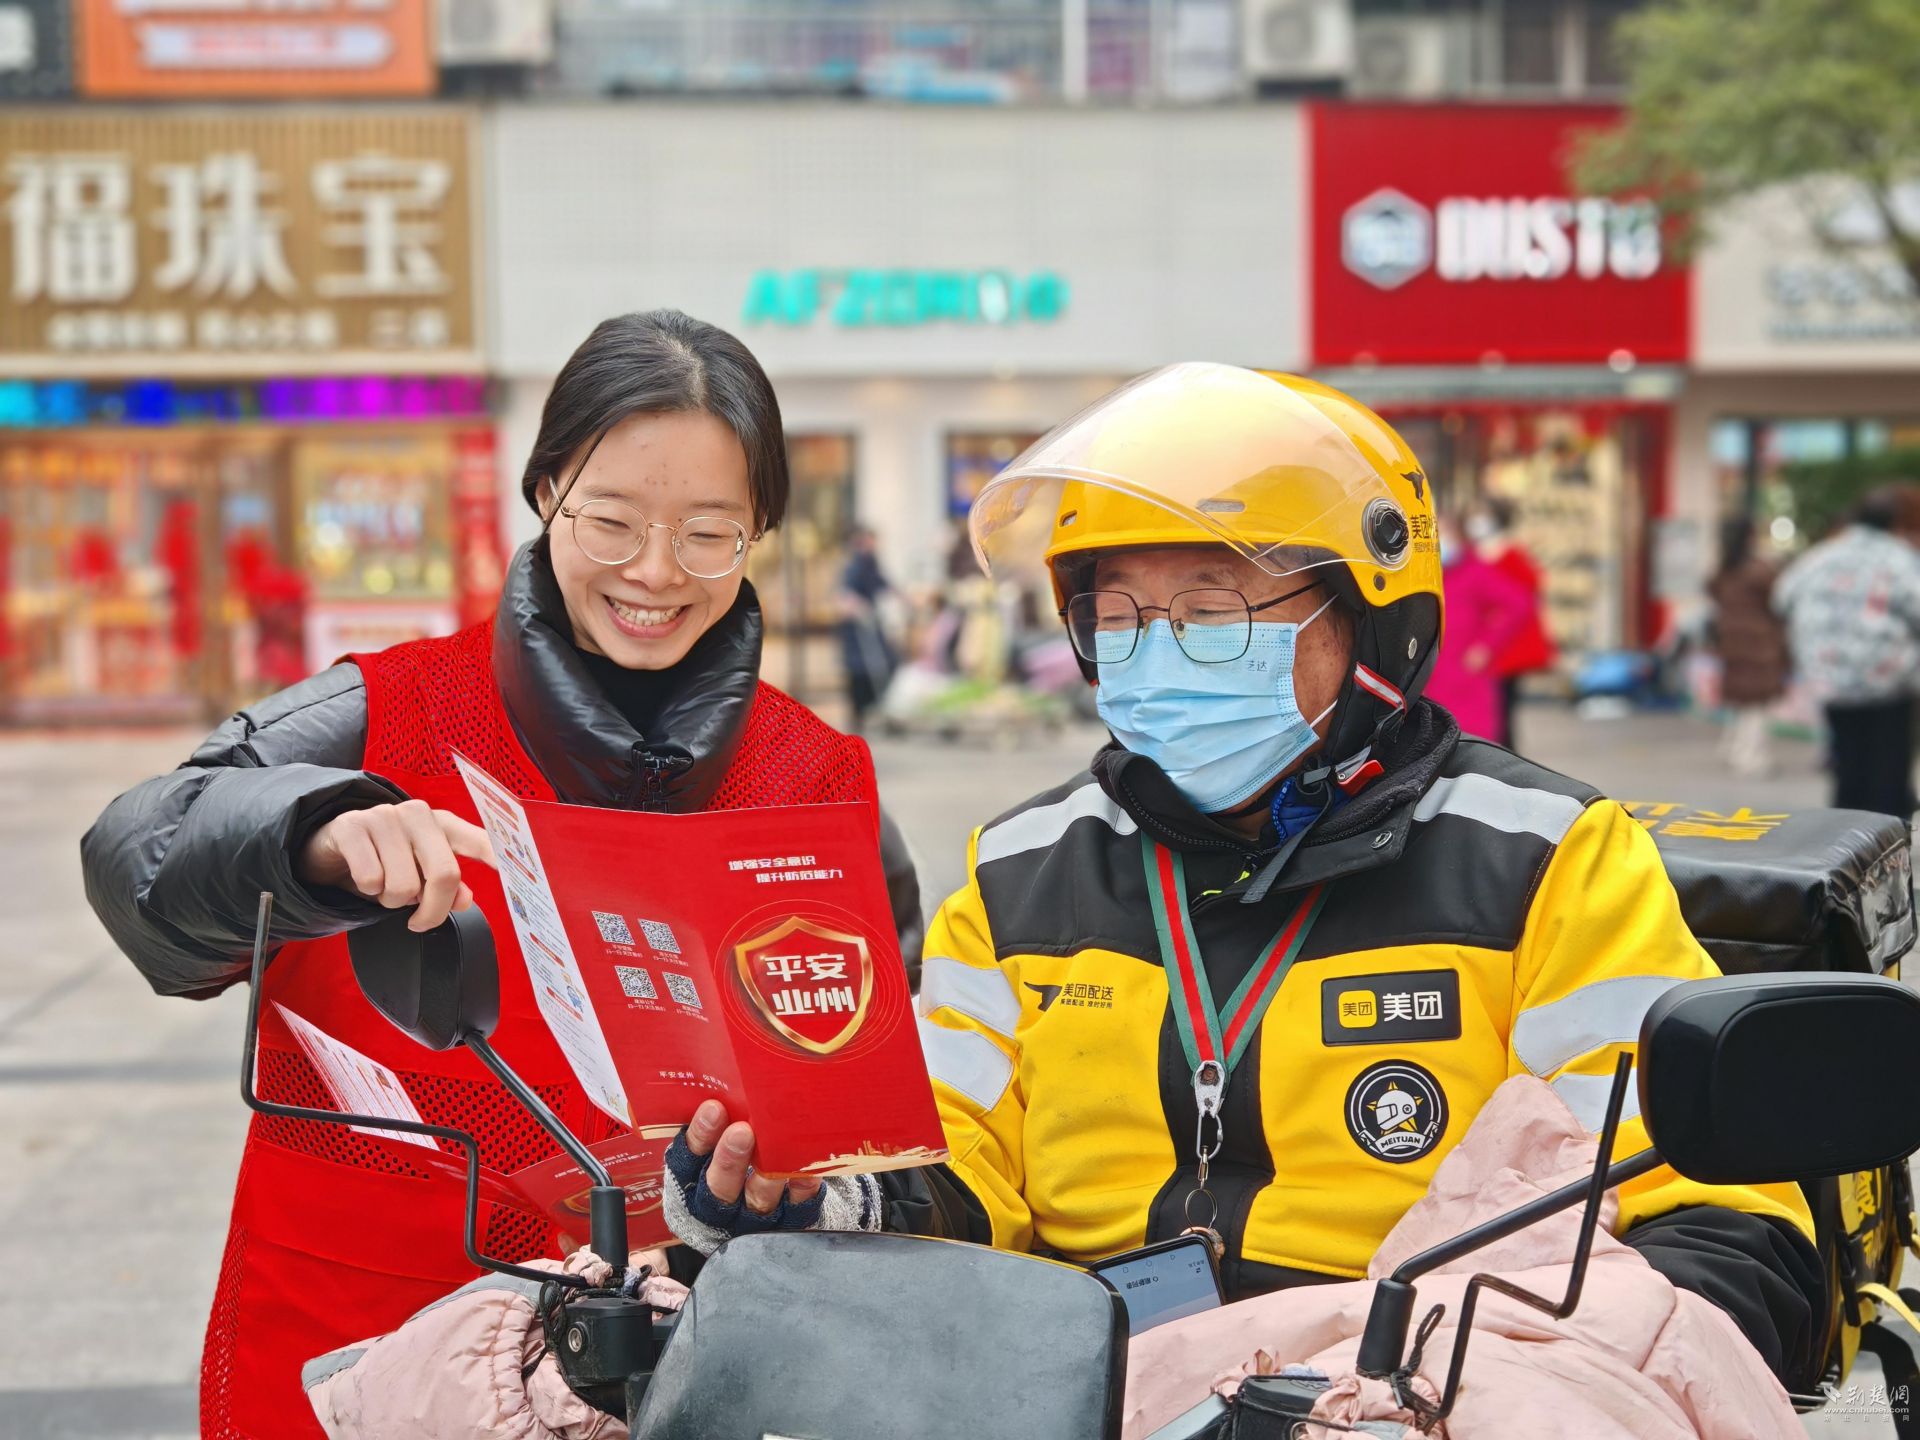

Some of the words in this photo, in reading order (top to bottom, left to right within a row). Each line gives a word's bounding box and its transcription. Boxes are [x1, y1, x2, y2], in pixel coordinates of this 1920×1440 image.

[729, 855, 817, 870] 增强安全意识
[756, 869, 843, 883] 提升防范能力
[764, 953, 849, 982] 平安
[1062, 983, 1114, 1000] 美团配送
[772, 986, 857, 1015] 业州
[1343, 1002, 1373, 1016] 美团
[1382, 991, 1443, 1022] 美团
[1380, 1135, 1421, 1149] MEITUAN
